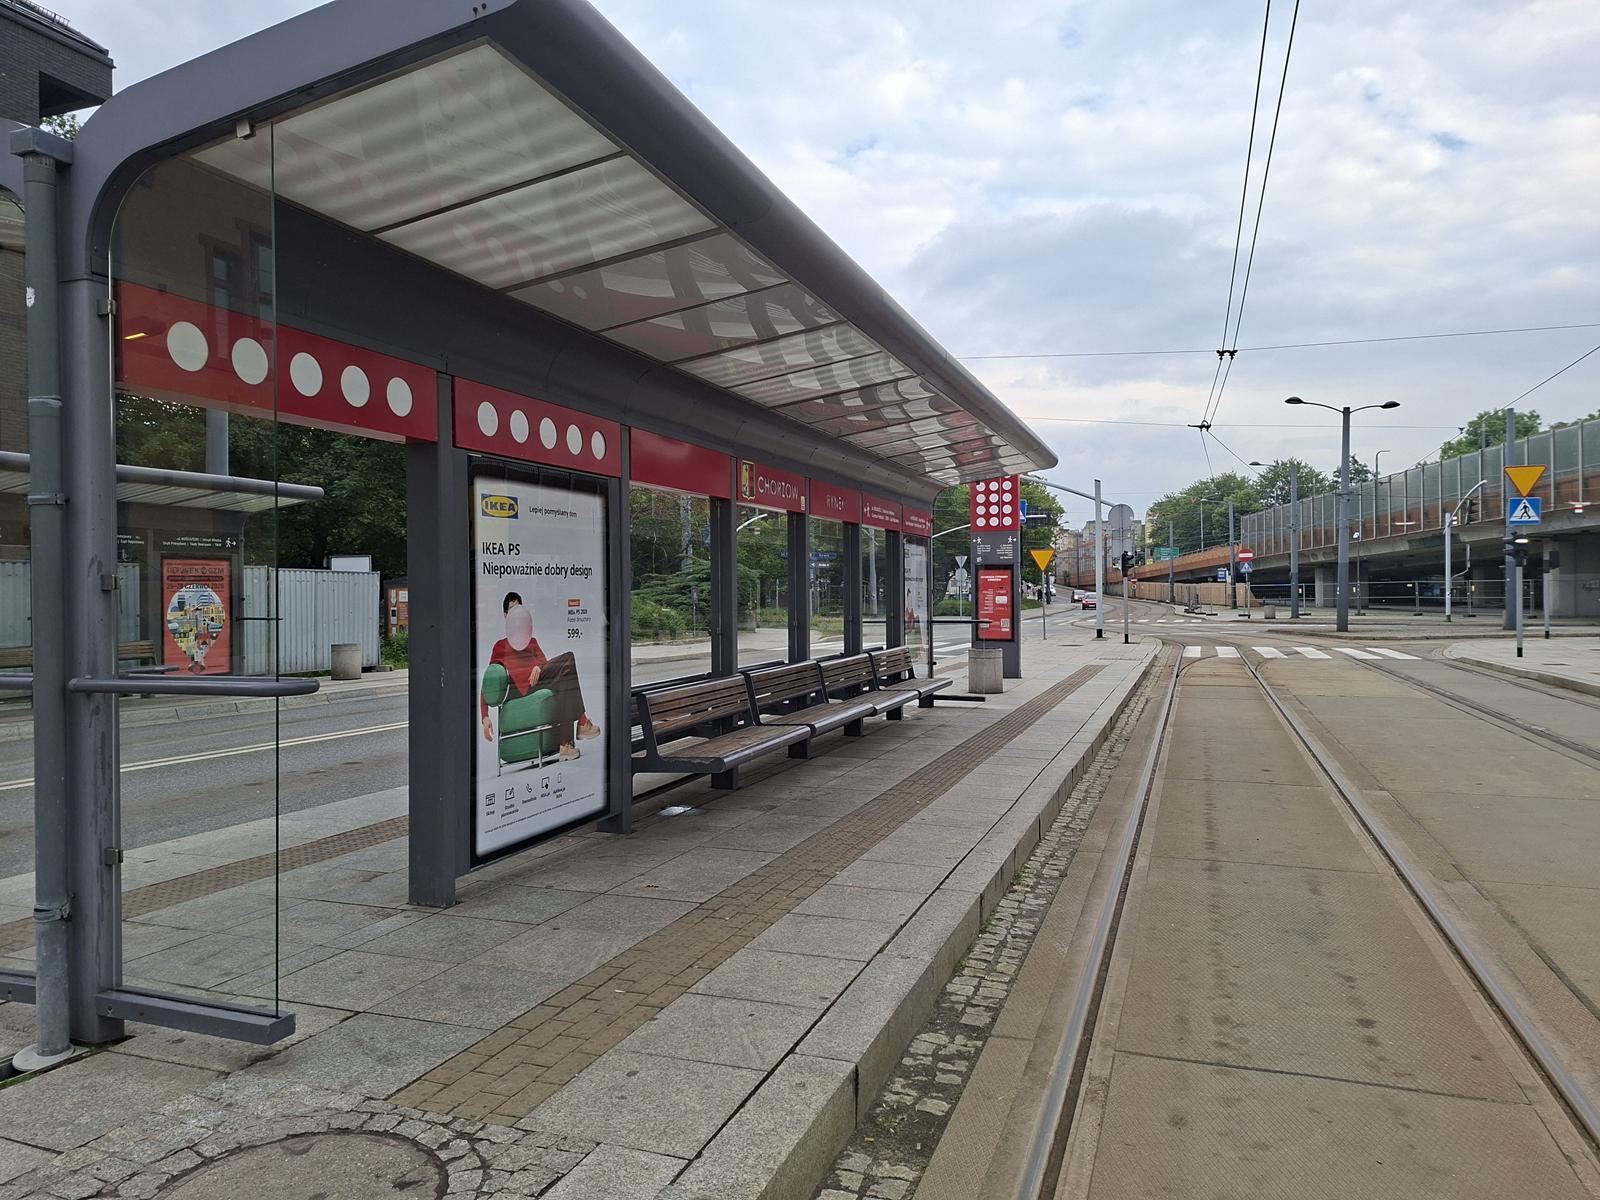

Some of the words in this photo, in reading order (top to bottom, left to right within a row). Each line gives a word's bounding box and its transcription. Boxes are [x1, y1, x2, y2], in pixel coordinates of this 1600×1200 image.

[484, 500, 516, 513] IKEA
[528, 506, 544, 516] Lepiej
[482, 541, 505, 555] IKEA
[508, 543, 521, 556] PS
[482, 561, 543, 578] Niepoważnie
[544, 563, 568, 579] dobry
[569, 564, 593, 579] design
[567, 628, 583, 639] 599,-
